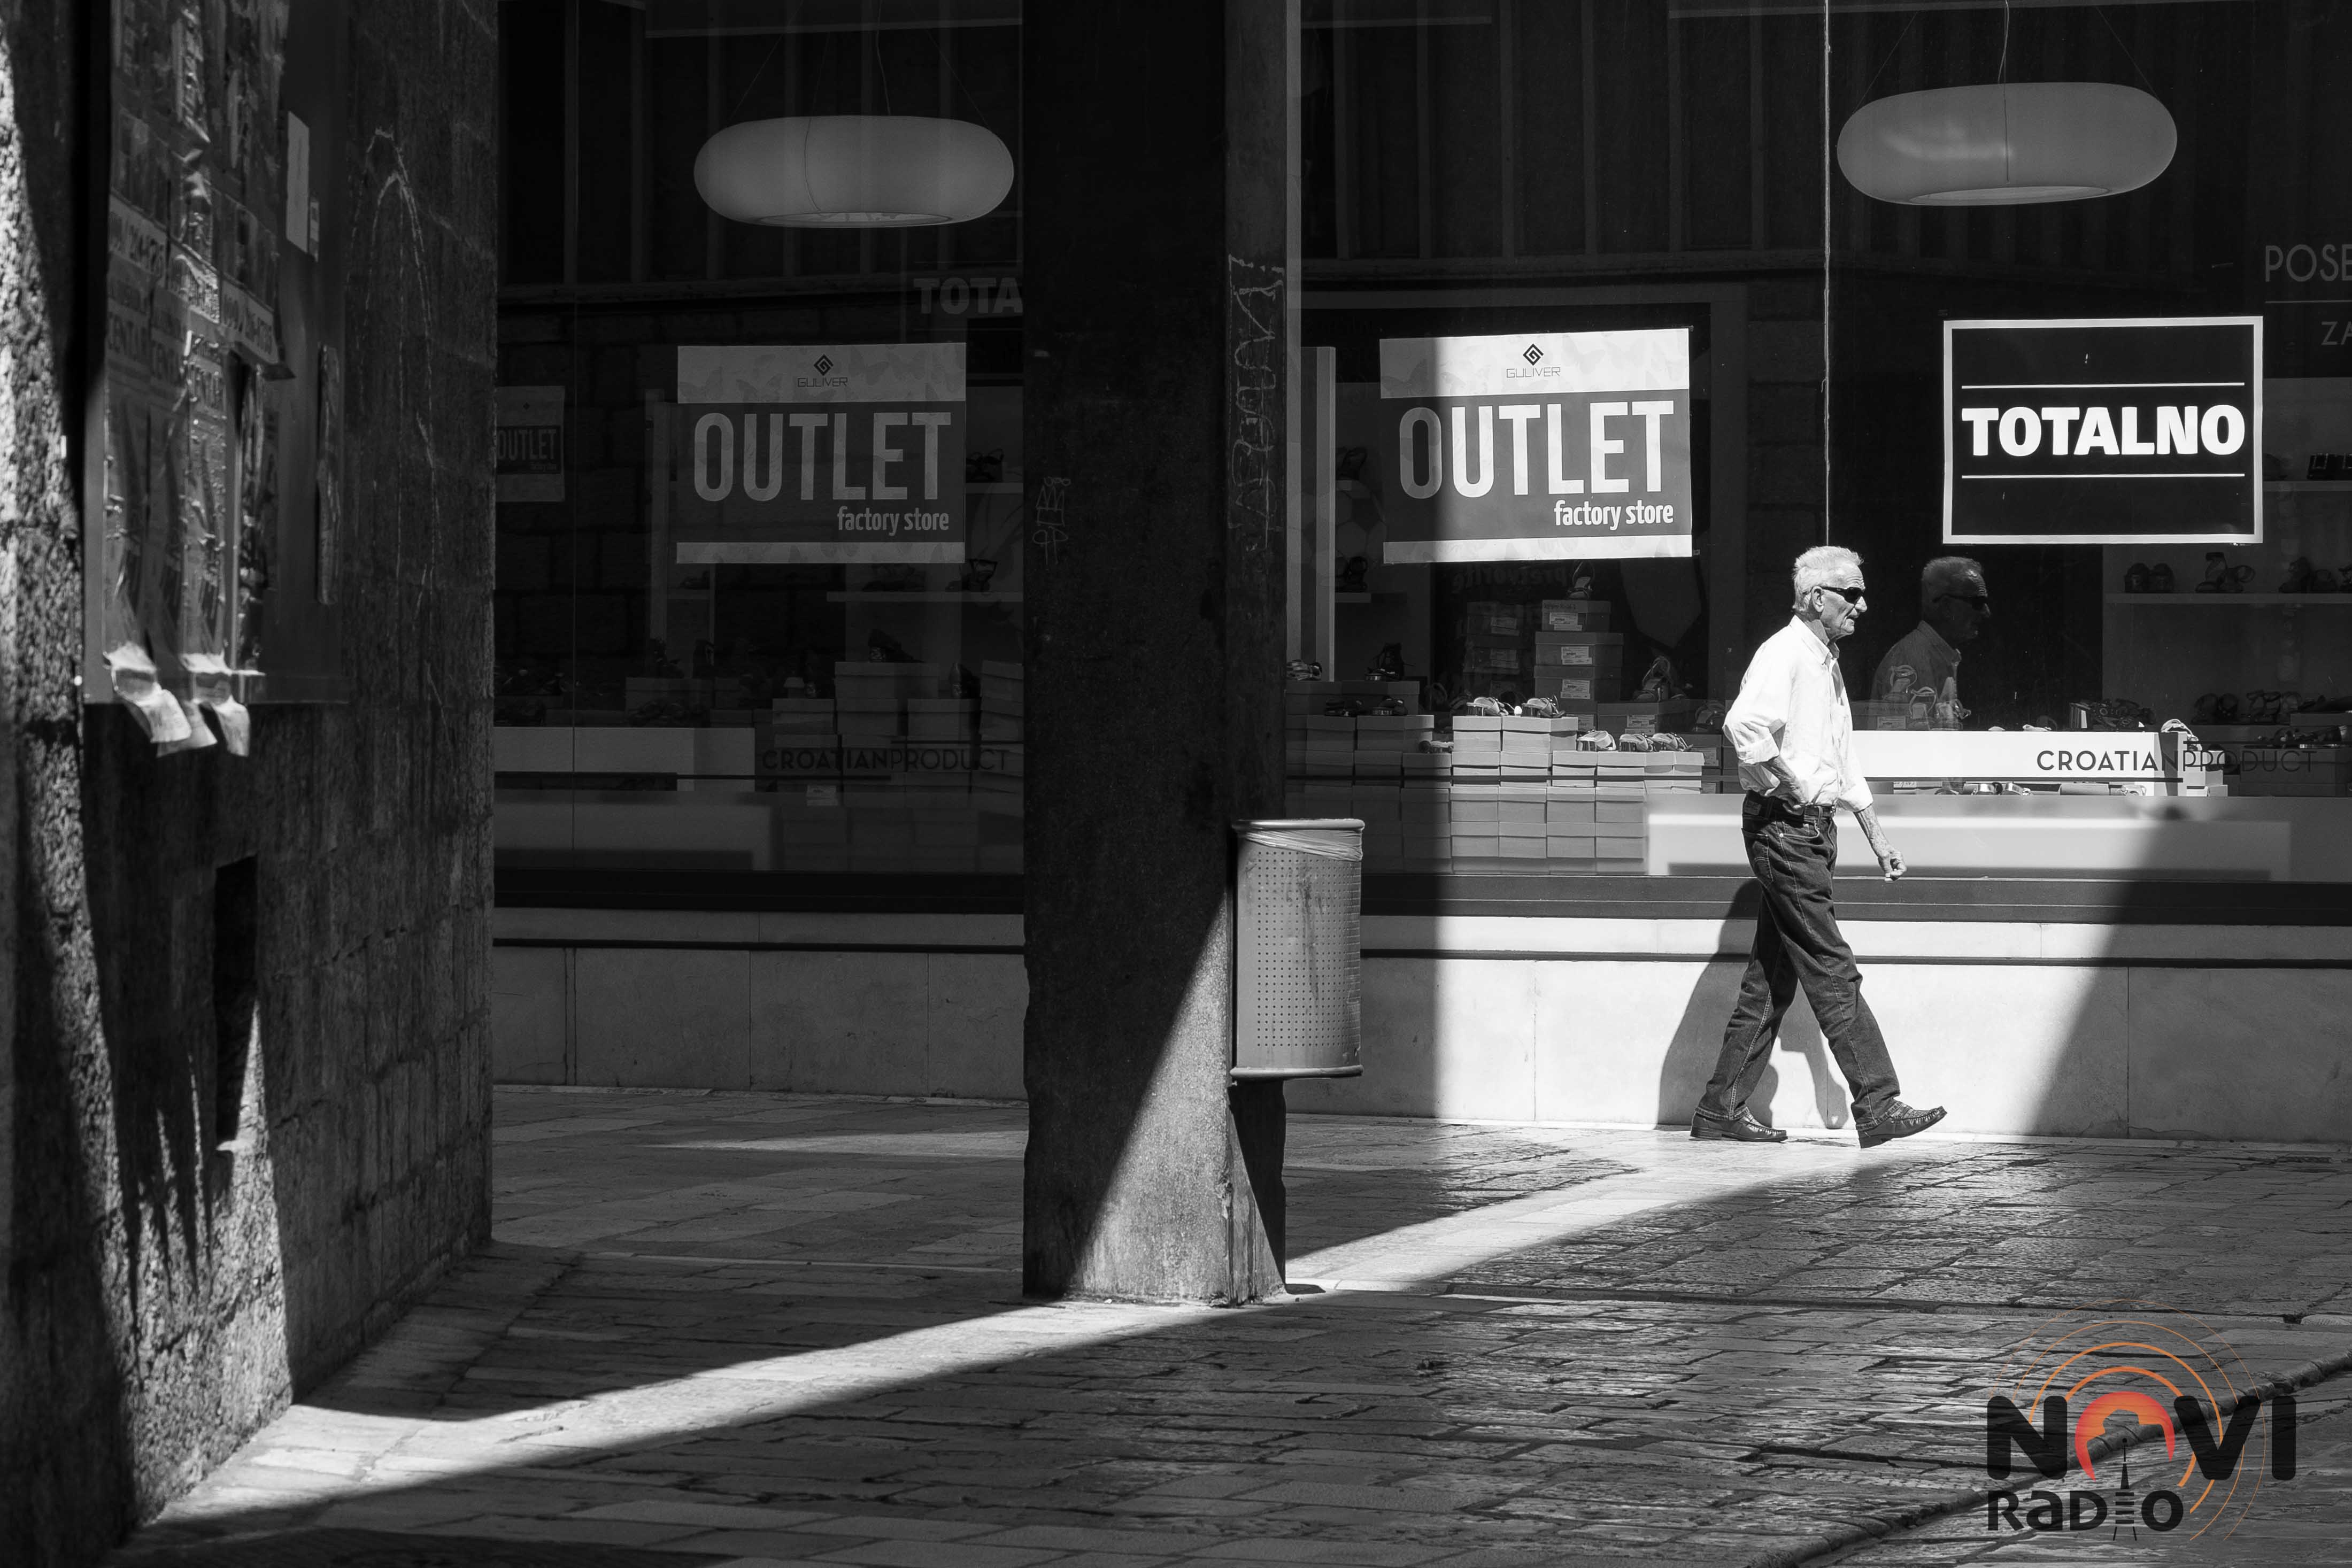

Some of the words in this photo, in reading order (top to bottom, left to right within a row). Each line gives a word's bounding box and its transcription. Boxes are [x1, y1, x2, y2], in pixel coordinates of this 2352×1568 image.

[914, 277, 1023, 314] TOTA
[797, 376, 848, 388] GULIVER
[1506, 367, 1561, 379] GULIVER
[498, 429, 557, 461] OUTLET
[1961, 404, 2245, 457] TOTALNO
[695, 412, 951, 501] OUTLET
[1399, 400, 1674, 499] OUTLET
[837, 506, 900, 536] factory
[903, 507, 950, 531] store
[1554, 499, 1622, 530] factory
[1625, 499, 1674, 524] store
